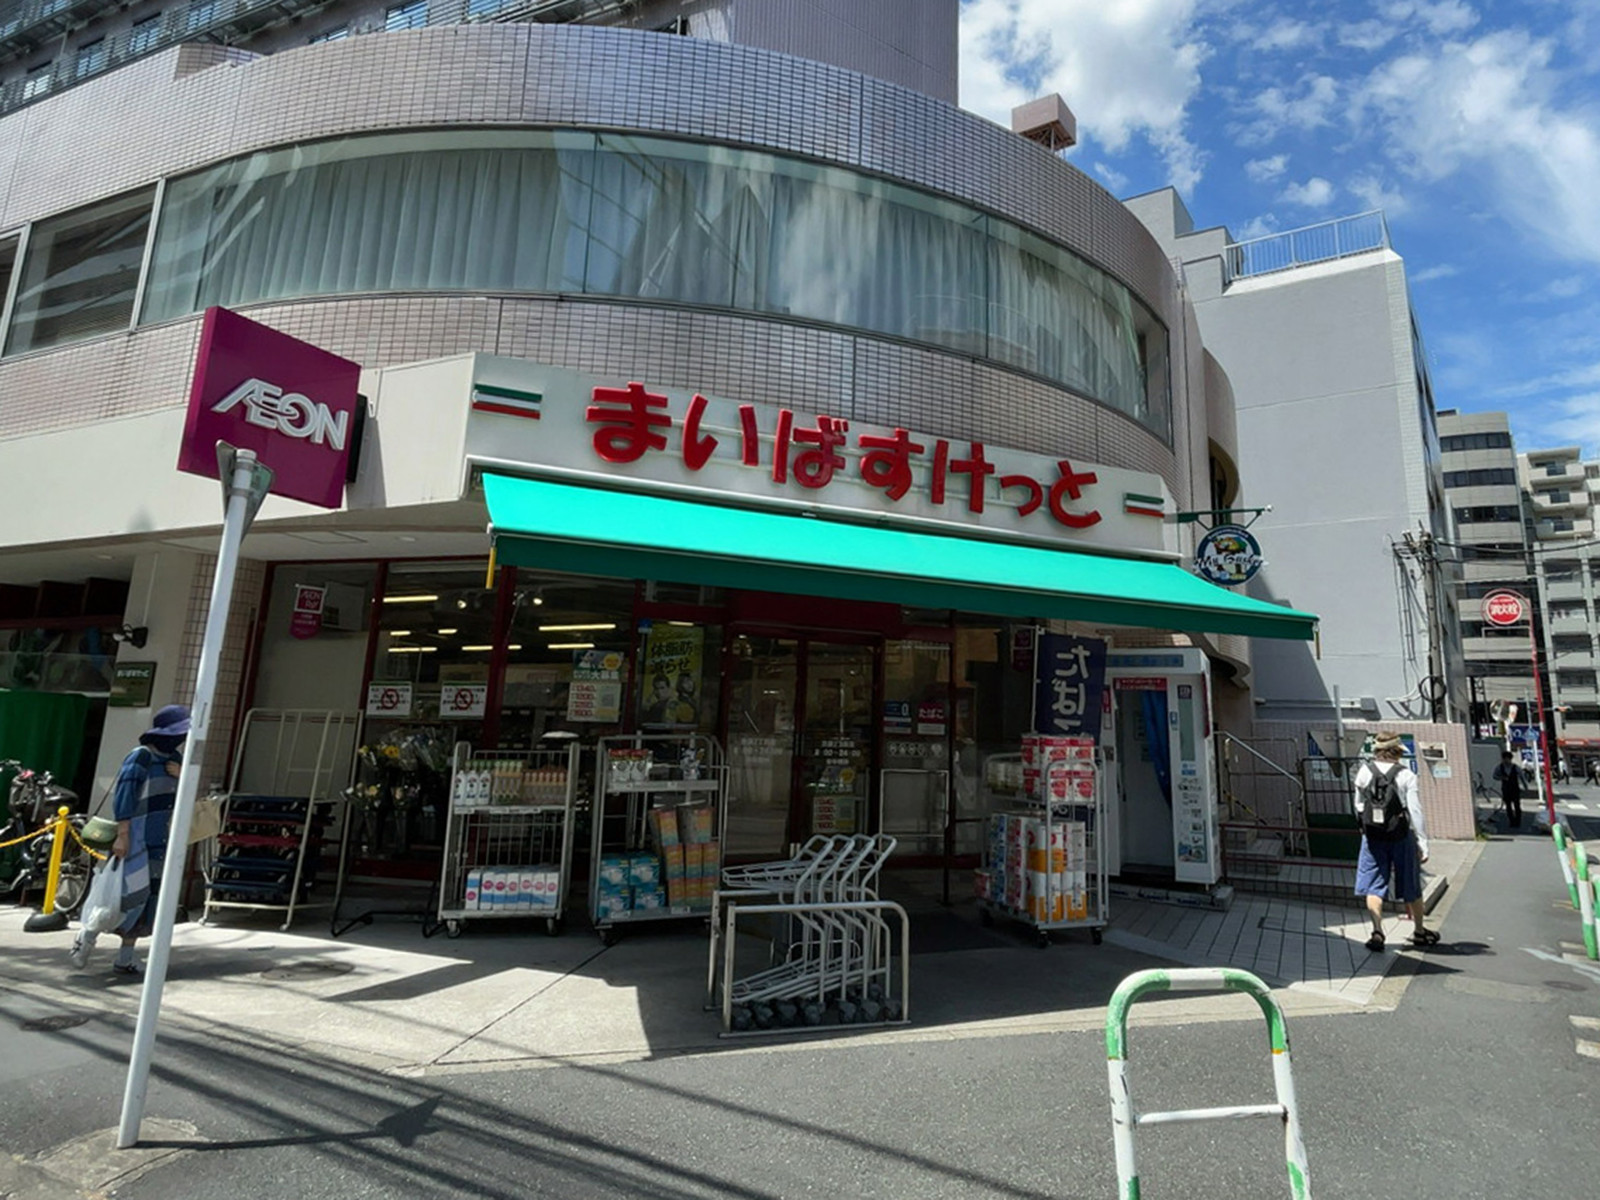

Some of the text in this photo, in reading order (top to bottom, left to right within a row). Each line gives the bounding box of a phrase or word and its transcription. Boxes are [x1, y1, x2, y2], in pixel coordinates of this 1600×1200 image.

[211, 378, 348, 450] AEON
[586, 381, 1102, 529] まいばすけっと
